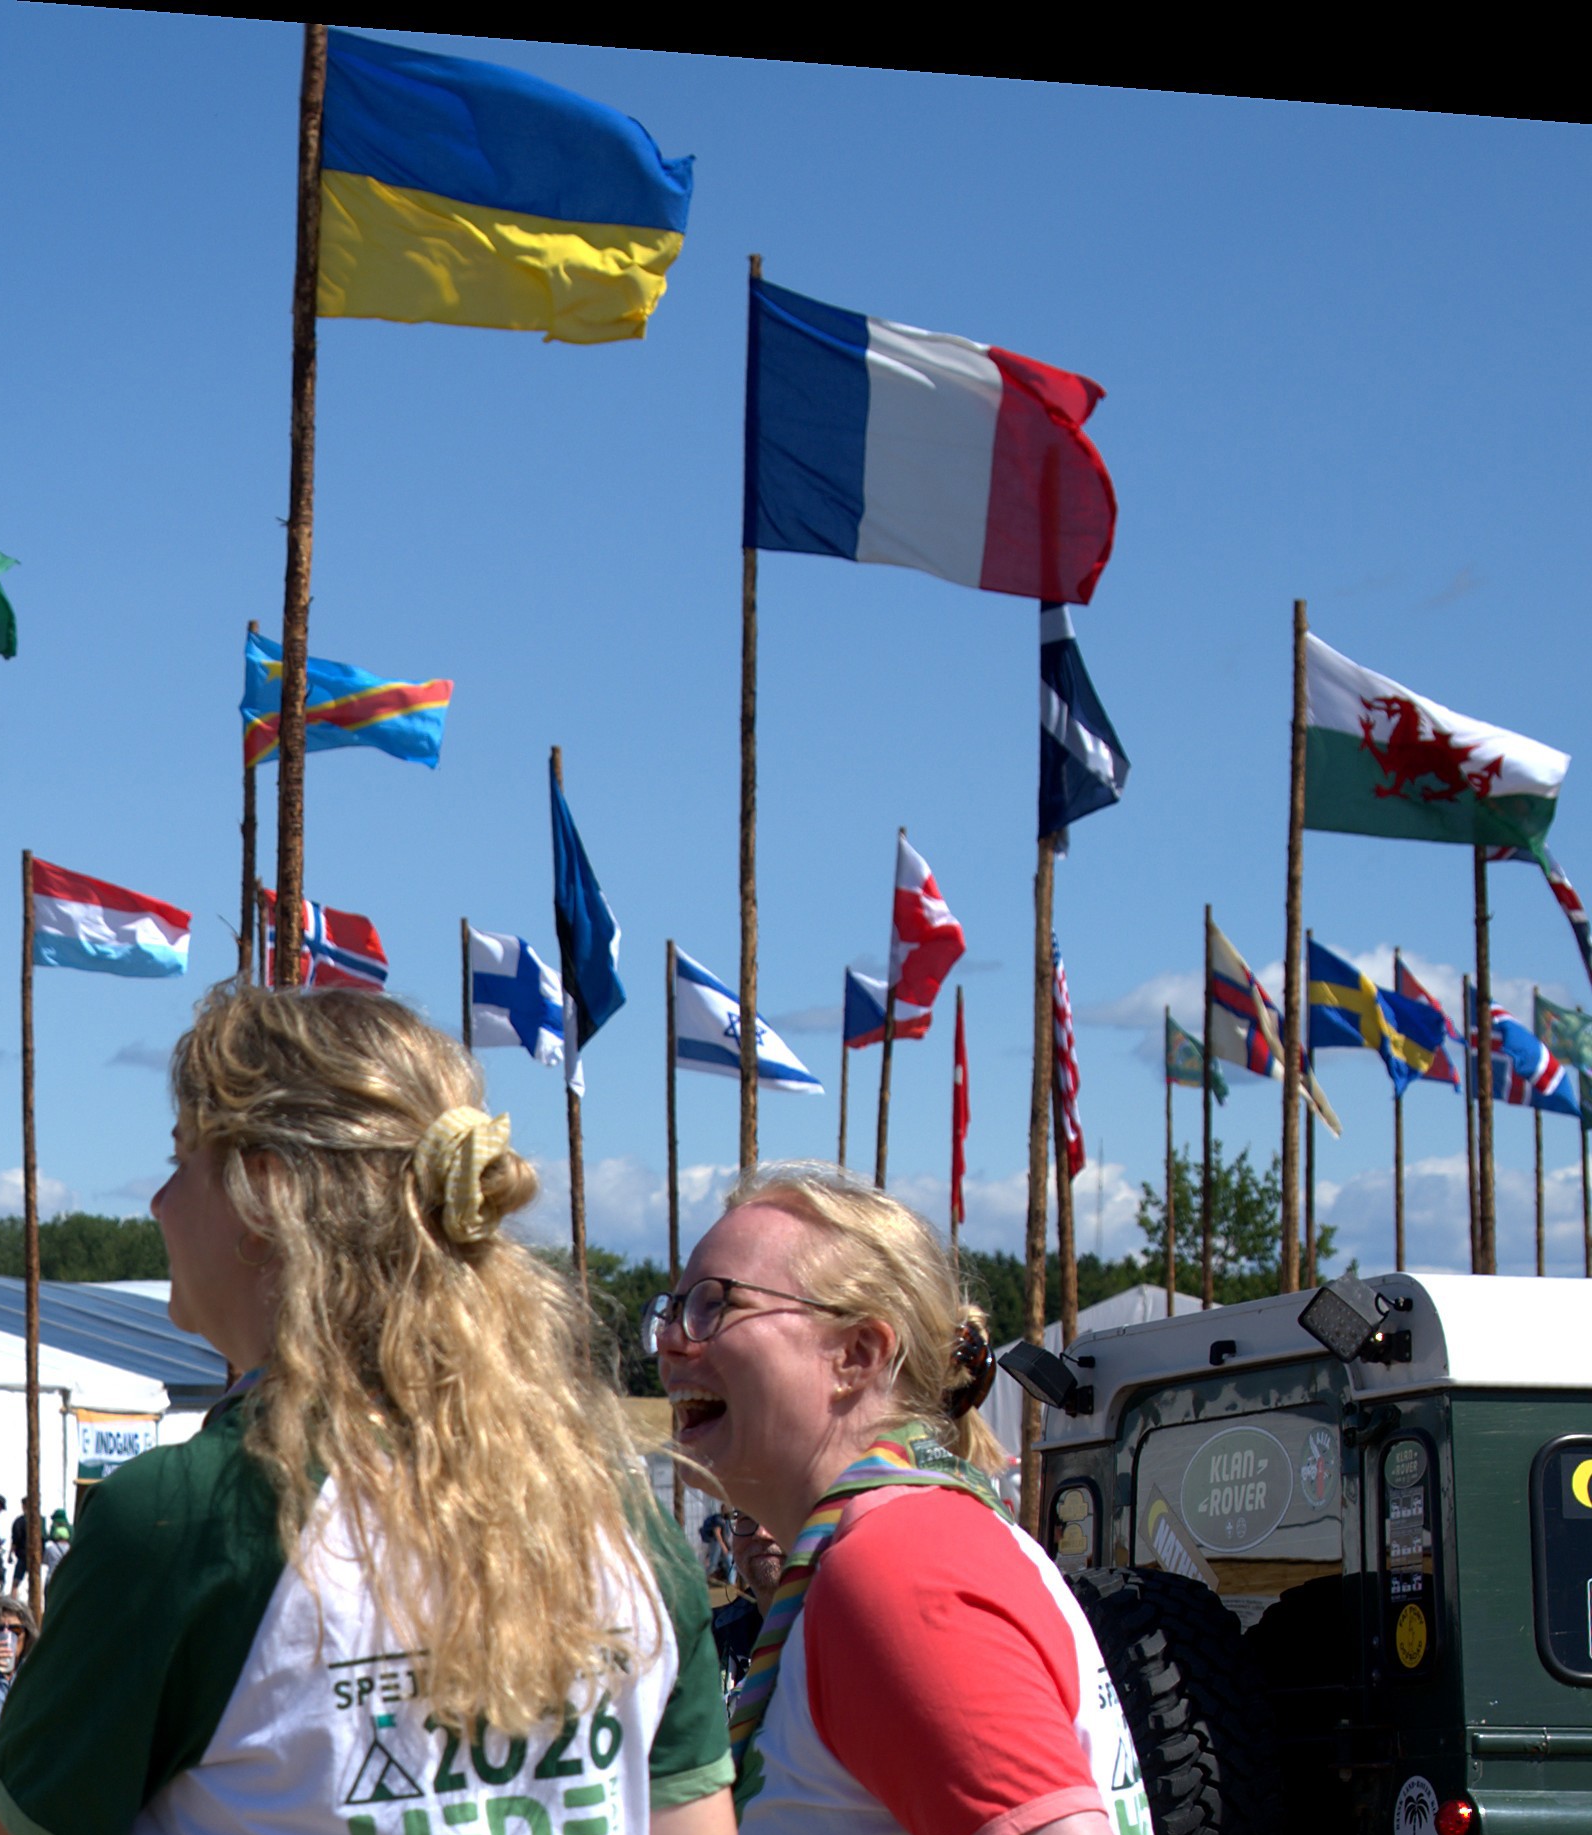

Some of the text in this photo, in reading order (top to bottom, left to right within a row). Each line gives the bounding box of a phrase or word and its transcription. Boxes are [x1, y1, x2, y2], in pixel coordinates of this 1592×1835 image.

[96, 1431, 140, 1456] INDGANG
[1209, 1450, 1255, 1483] KLAN
[1209, 1481, 1267, 1517] ROVER
[423, 1692, 623, 1793] 2026
